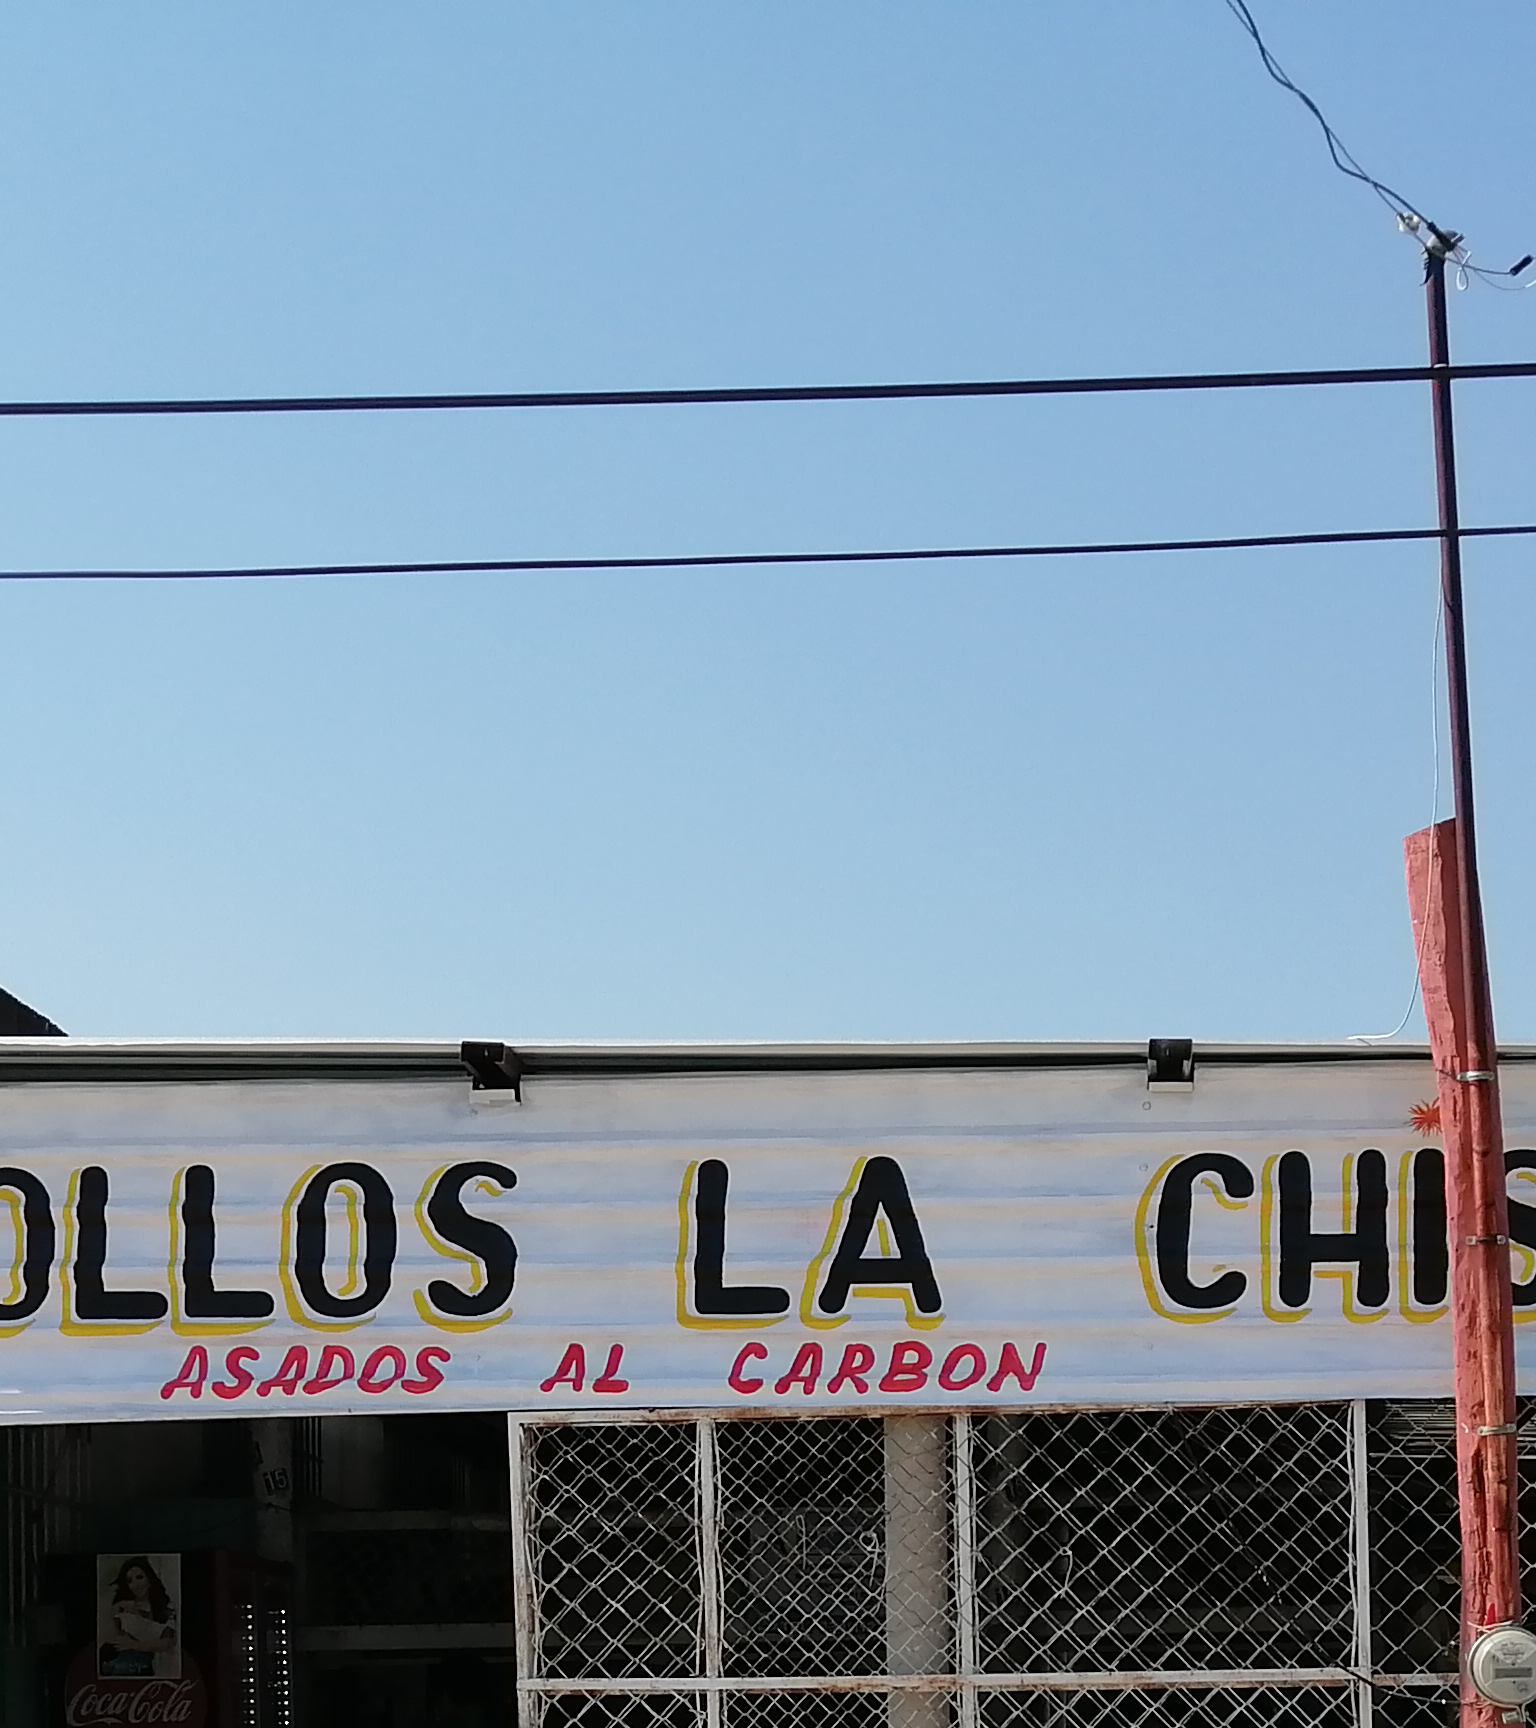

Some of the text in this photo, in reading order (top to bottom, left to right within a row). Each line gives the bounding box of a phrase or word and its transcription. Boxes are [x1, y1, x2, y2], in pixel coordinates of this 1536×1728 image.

[675, 1156, 946, 1330] LA
[161, 1341, 1047, 1400] ASADOS AL CARBON
[67, 1679, 199, 1727] Coca-Cola
